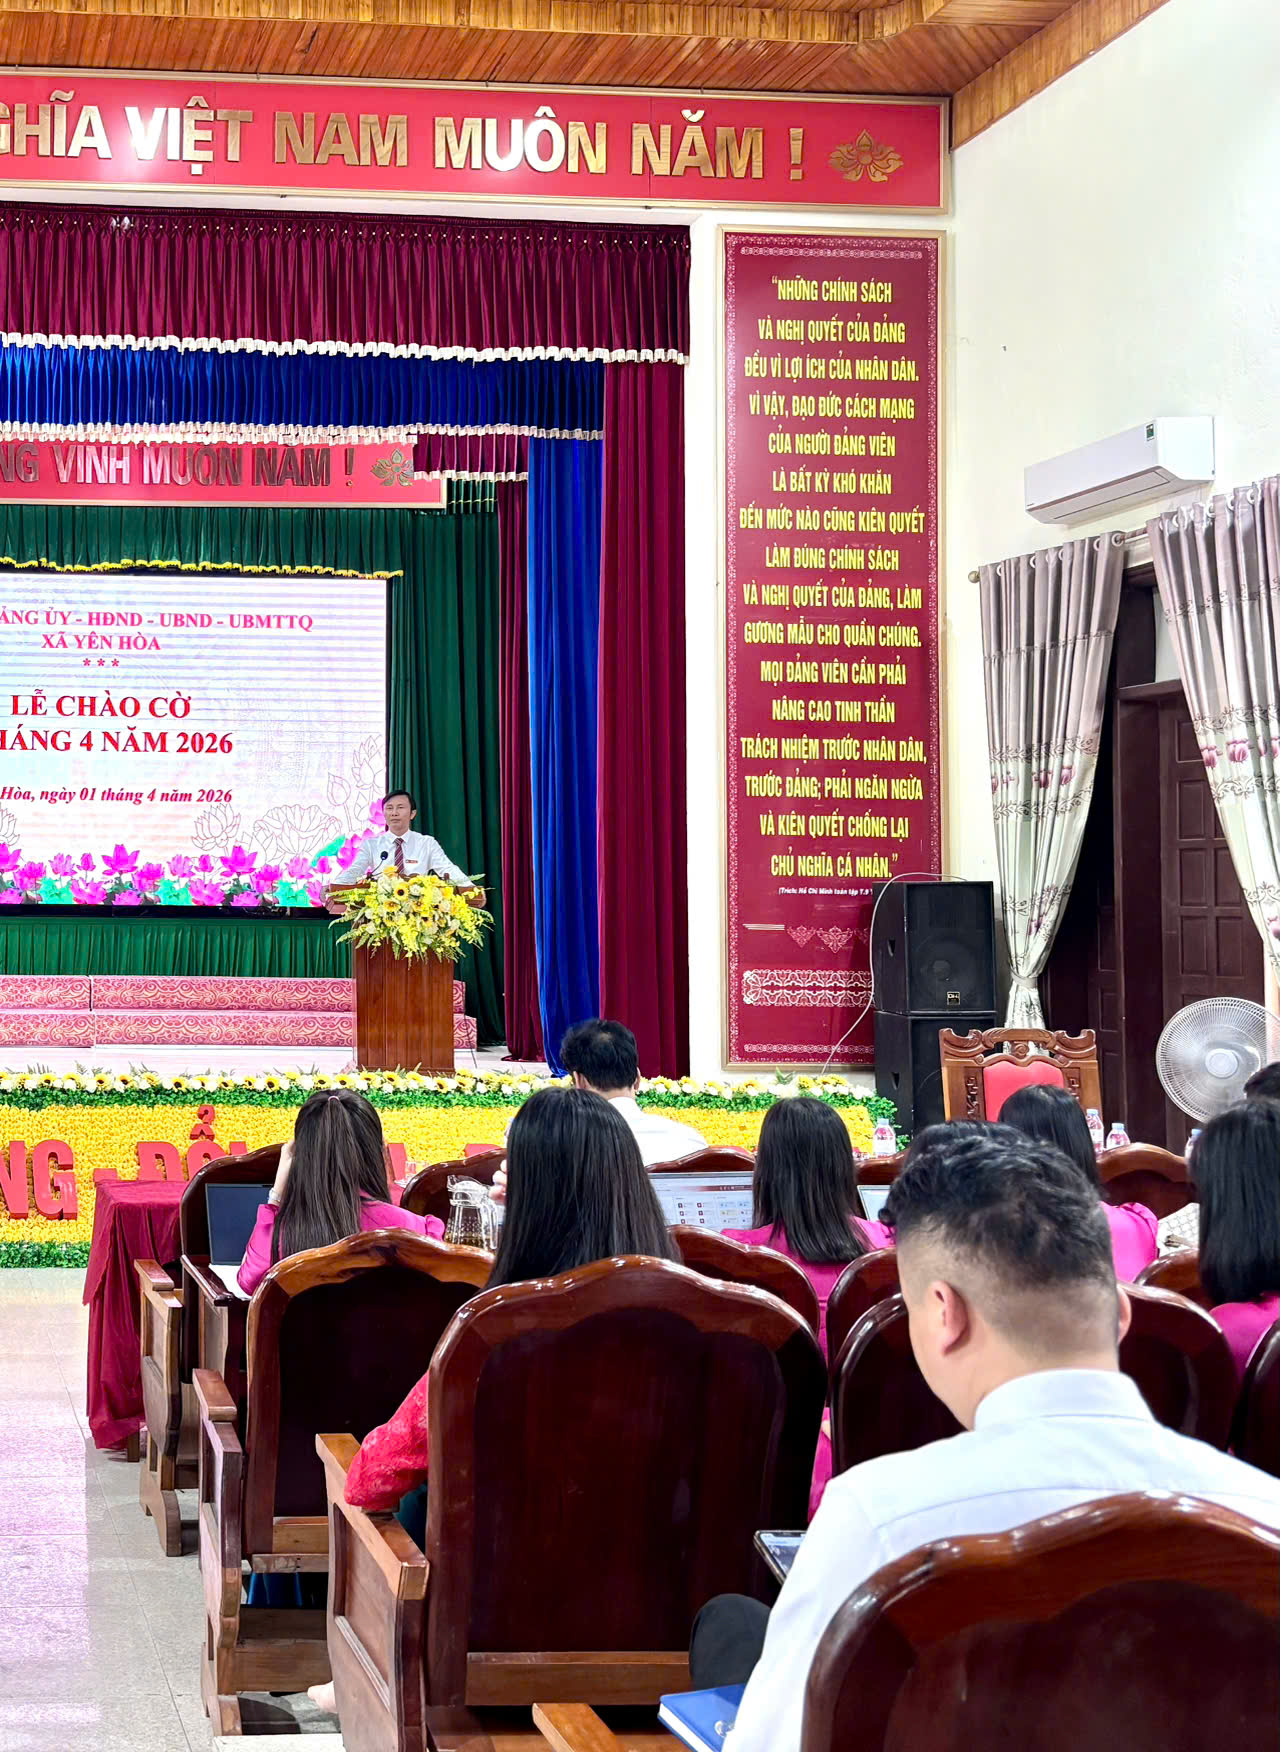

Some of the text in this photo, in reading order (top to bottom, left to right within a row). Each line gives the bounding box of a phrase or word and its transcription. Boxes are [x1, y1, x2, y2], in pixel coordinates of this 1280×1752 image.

[125, 96, 253, 174] VIỆT
[275, 112, 407, 167] NAM
[434, 106, 607, 175] MUÔN
[631, 108, 764, 179] NĂM
[788, 127, 803, 180] !
[822, 277, 857, 302] CHÍNH
[861, 278, 891, 302] SÁCH
[745, 349, 767, 377] ĐỀU
[772, 353, 781, 378] VÌ
[785, 356, 802, 383] LỢI
[806, 354, 825, 378] ÍCH
[829, 350, 852, 379] CỦA
[856, 356, 888, 380] NHÂN
[768, 424, 895, 456] CỦA NGƯỜI ĐẢNG VIÊN
[53, 445, 130, 484] VINH
[740, 500, 924, 534] ĐẾN MỨC NÀO CŨNG KIÊN QUYẾT
[744, 580, 758, 605] VÀ
[762, 584, 789, 610] NGHỊ
[793, 579, 828, 608] QUYẾT
[832, 578, 855, 607] CỦA
[898, 584, 921, 608] LÀM
[43, 606, 72, 626] ỦY
[87, 612, 142, 627] HĐND
[160, 613, 212, 628] UBND
[229, 614, 313, 631] UBMTTQ
[41, 631, 161, 651] XÃ YÊN HÒA
[761, 653, 906, 686] MỌI ĐẢNG VIÊN CẦN PHẢI
[10, 689, 192, 718] LỄ CHÀO CỜ
[773, 695, 894, 722] NÂNG CAO TINH THẦN
[79, 731, 94, 751] 4
[101, 725, 169, 752] NĂM
[176, 732, 233, 754] 2026
[741, 733, 778, 758] TRÁCH
[782, 734, 819, 763] NHIỆM
[824, 734, 860, 760] TRƯỚC
[864, 736, 896, 761] NHÂN
[0, 786, 35, 802] Hòa,
[40, 788, 76, 803] ngày
[79, 787, 95, 800] 01
[101, 787, 144, 804] tháng
[147, 788, 157, 801] 4
[160, 789, 192, 802] năm
[197, 789, 232, 803] 2026
[760, 808, 908, 842] VÀ KIÊN QUYẾT CHỐNG LẠI
